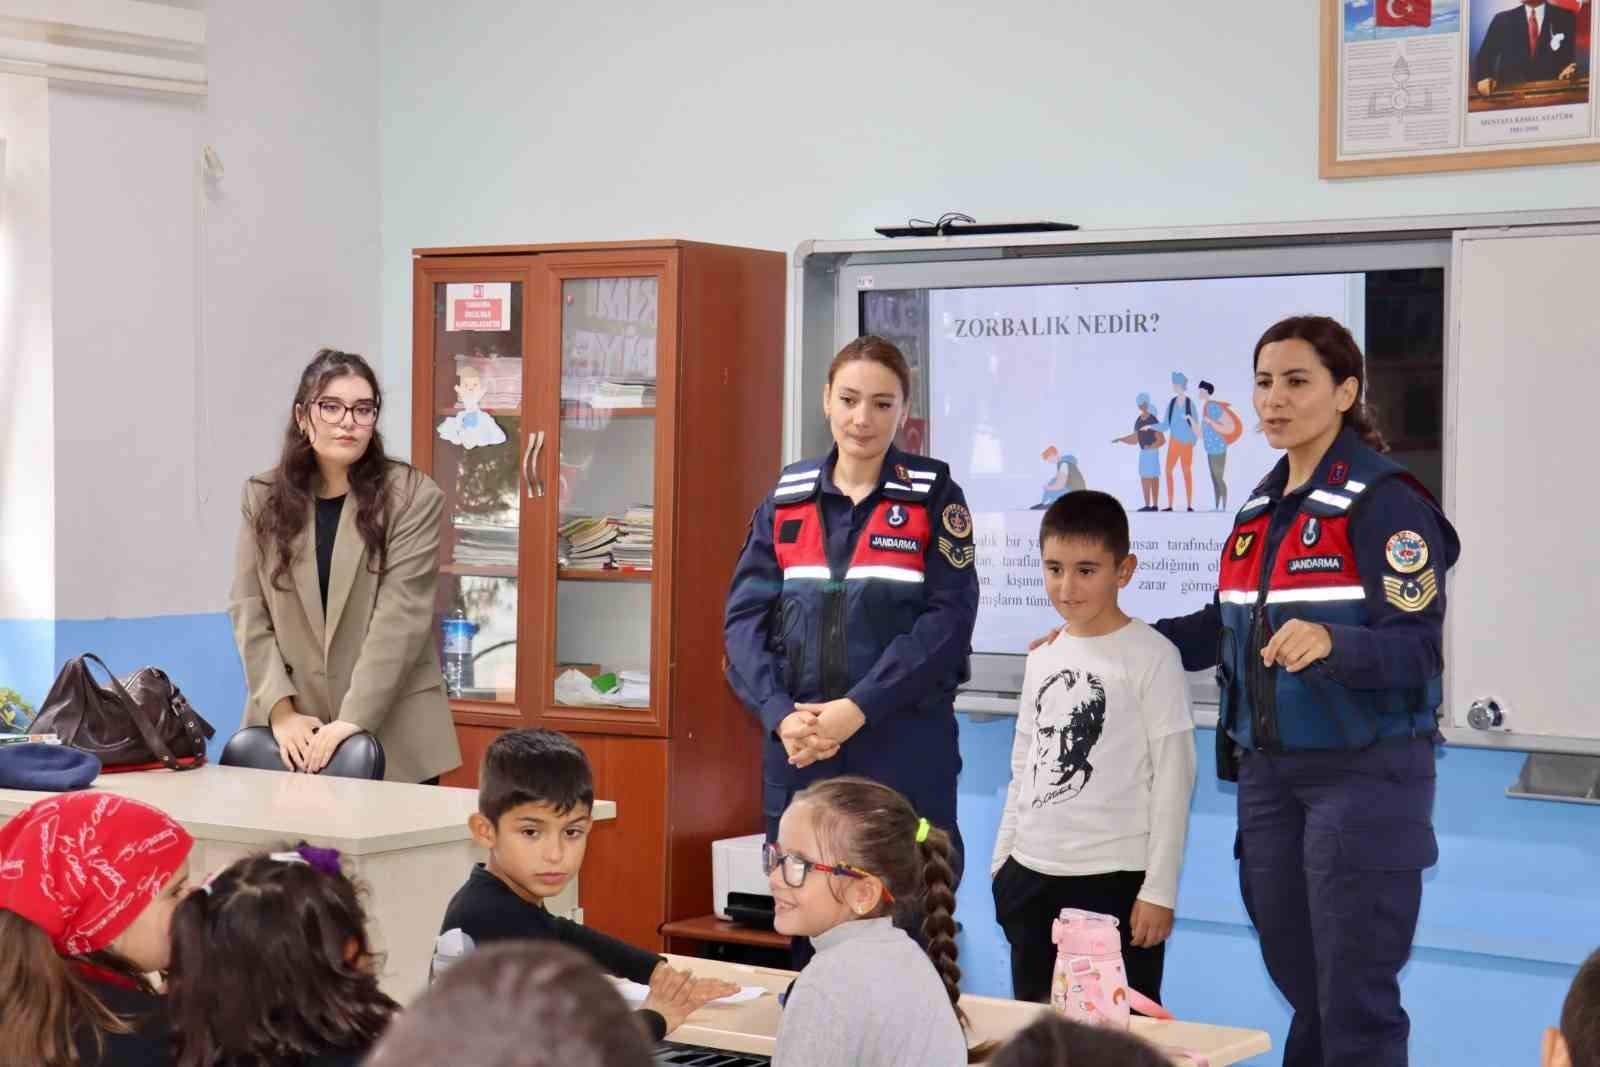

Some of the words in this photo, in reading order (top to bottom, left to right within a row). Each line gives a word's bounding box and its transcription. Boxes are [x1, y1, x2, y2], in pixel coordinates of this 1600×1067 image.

[954, 316, 1070, 337] ZORBALIK
[1076, 308, 1160, 335] NEDİR?
[872, 537, 917, 550] JANDARMA
[1129, 538, 1159, 551] nsan
[1138, 558, 1200, 575] esizliğinin
[1207, 559, 1220, 572] ol
[1290, 558, 1340, 571] JANDARMA
[1180, 579, 1220, 595] görme
